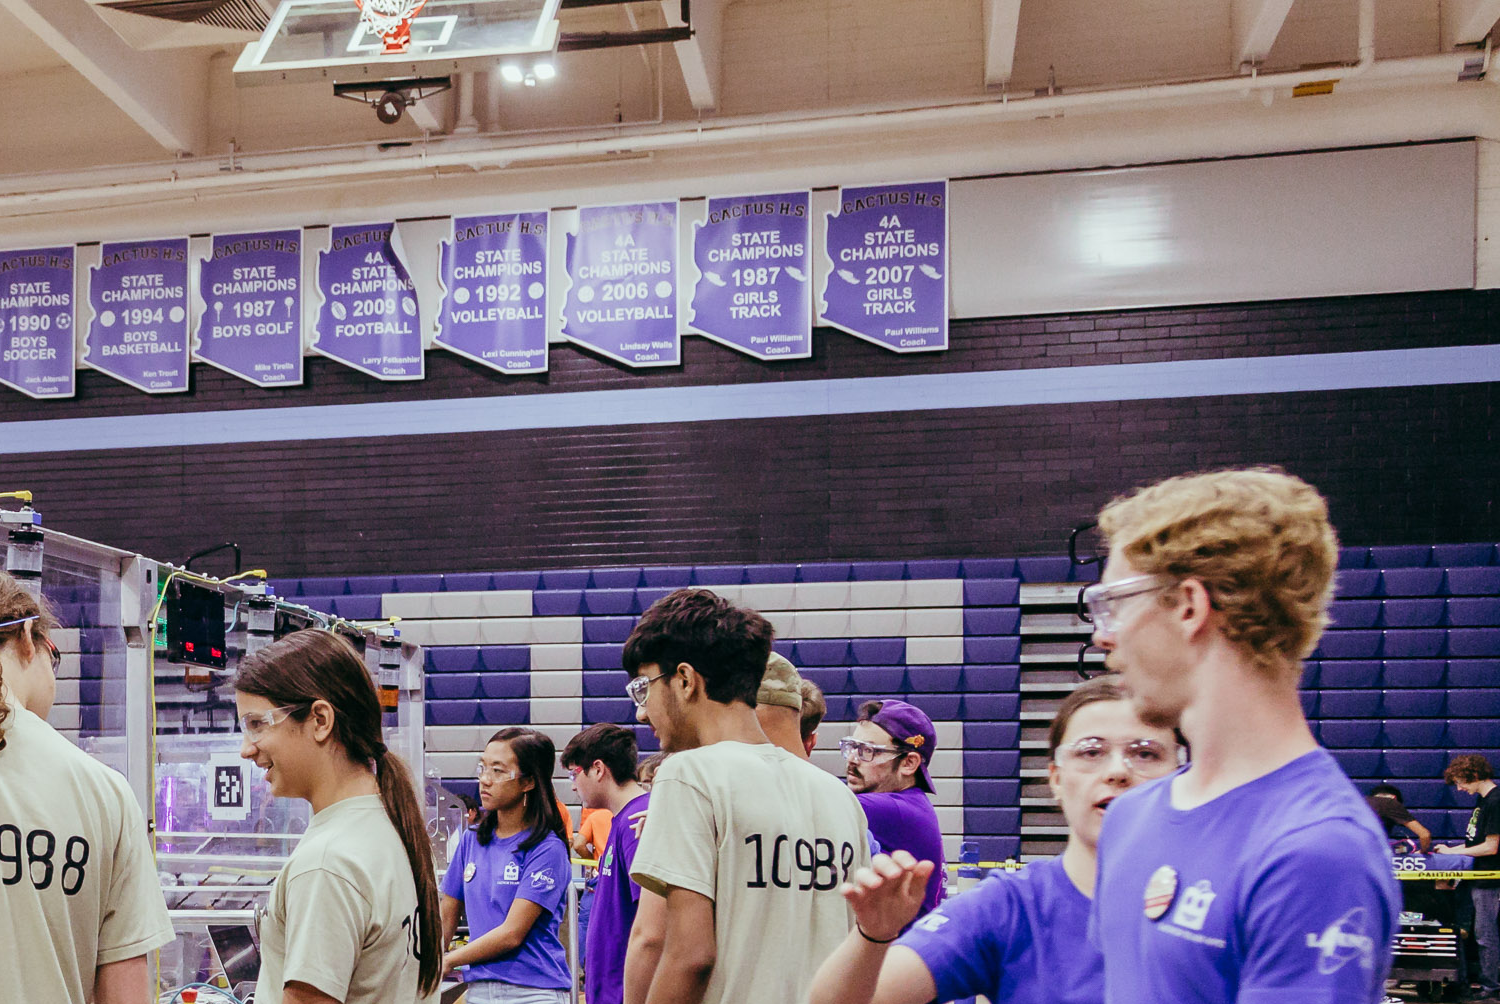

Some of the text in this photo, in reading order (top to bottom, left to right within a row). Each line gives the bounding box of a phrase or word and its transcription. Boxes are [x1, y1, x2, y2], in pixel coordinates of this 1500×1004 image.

[843, 192, 909, 215] CACTUS
[710, 202, 774, 224] CACTUS
[879, 215, 901, 228] 4A
[455, 221, 513, 242] CACTUS
[731, 230, 780, 246] STATE
[864, 230, 915, 245] STATE
[333, 231, 390, 251] CACTUS
[614, 234, 635, 247] 4A
[213, 239, 270, 259] CACTUS
[475, 249, 521, 264] STATE
[601, 249, 648, 262] STATE
[708, 244, 803, 263] CHAMPIONS
[840, 243, 939, 262] CHAMPIONS
[104, 248, 158, 267] CACTUS
[365, 252, 383, 264] 4A
[233, 266, 276, 280] STATE
[352, 266, 395, 280] STATE
[454, 261, 542, 280] CHAMPIONS
[579, 261, 671, 279] CHAMPIONS
[732, 267, 781, 286] 1987
[865, 265, 915, 285] 2007
[10, 282, 50, 295] STATE
[122, 274, 163, 288] STATE
[213, 278, 296, 295] CHAMPIONS
[331, 278, 414, 295] CHAMPIONS
[102, 286, 183, 303] CHAMPIONS
[475, 284, 521, 303] 1992
[602, 283, 648, 301] 2006
[733, 291, 778, 305] GIRLS
[867, 287, 912, 301] GIRLS
[233, 301, 275, 319] 1987
[353, 299, 395, 317] 2009
[451, 306, 542, 324] VOLLEYBALL
[577, 306, 673, 323] VOLLEYBALL
[730, 304, 781, 319] TRACK
[863, 300, 915, 315] TRACK
[10, 315, 50, 332] 1990
[121, 308, 164, 325] 1994
[124, 331, 157, 343] BOYS
[213, 322, 293, 338] BOYS GOLF
[336, 322, 412, 337] FOOTBALL
[885, 326, 939, 336] Paul Williams
[11, 336, 47, 348] BOYS
[751, 334, 803, 344] Paul Williams
[900, 338, 926, 346] Coach
[4, 349, 56, 362] SOCCER
[102, 342, 182, 356] BASKETBALL
[635, 353, 659, 361] Coach
[766, 346, 790, 354] Coach
